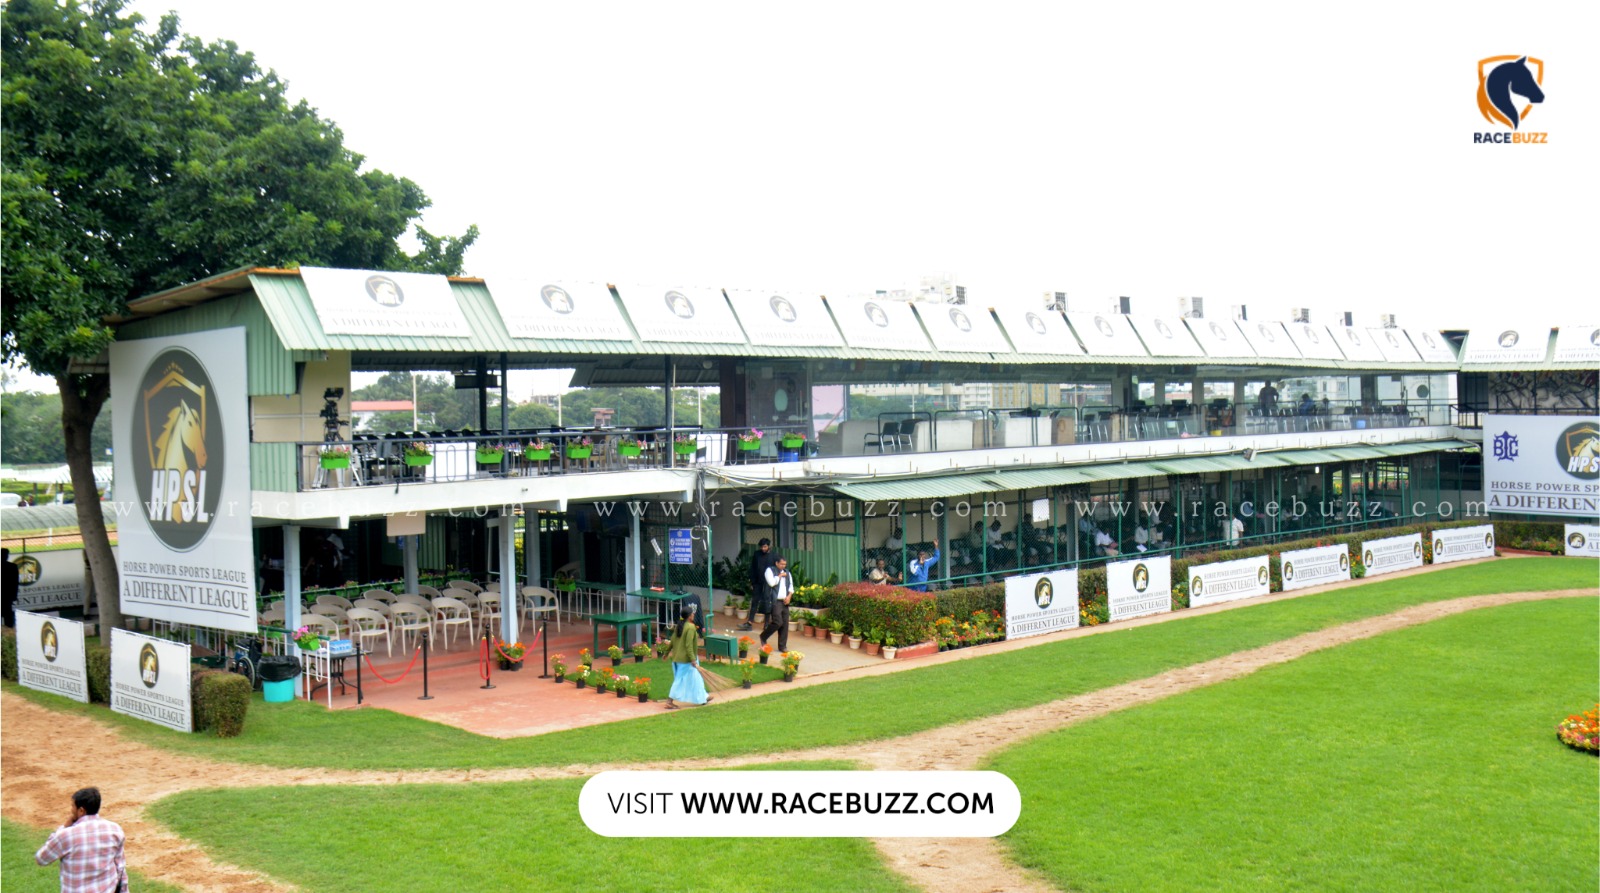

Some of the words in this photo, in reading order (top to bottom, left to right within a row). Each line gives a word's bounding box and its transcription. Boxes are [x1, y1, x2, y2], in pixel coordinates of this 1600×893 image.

[150, 470, 208, 522] HPSL
[1491, 481, 1532, 490] HORSE
[1536, 482, 1580, 492] POWER
[1489, 494, 1502, 507] A
[124, 561, 148, 574] HORSE
[150, 563, 177, 576] POWER
[179, 565, 210, 579] SPORTS
[212, 568, 246, 584] LEAGUE
[23, 586, 50, 594] SPORTS
[52, 583, 80, 591] LEAGUE
[42, 592, 81, 604] LEAGUE
[124, 580, 132, 597] A
[133, 580, 197, 604] DIFFERENT
[199, 587, 249, 612] LEAGUE
[1118, 602, 1147, 614] DIFFERENT
[1148, 598, 1168, 608] LEAGUE
[1011, 625, 1016, 634] A
[1016, 618, 1052, 633] DIFFERENT
[1052, 615, 1075, 627] LEAGUE
[27, 672, 58, 688] DIFFERENT
[58, 680, 82, 694] LEAGUE
[115, 696, 120, 706] A
[120, 696, 156, 717] DIFFERENT
[158, 706, 185, 725] LEAGUE
